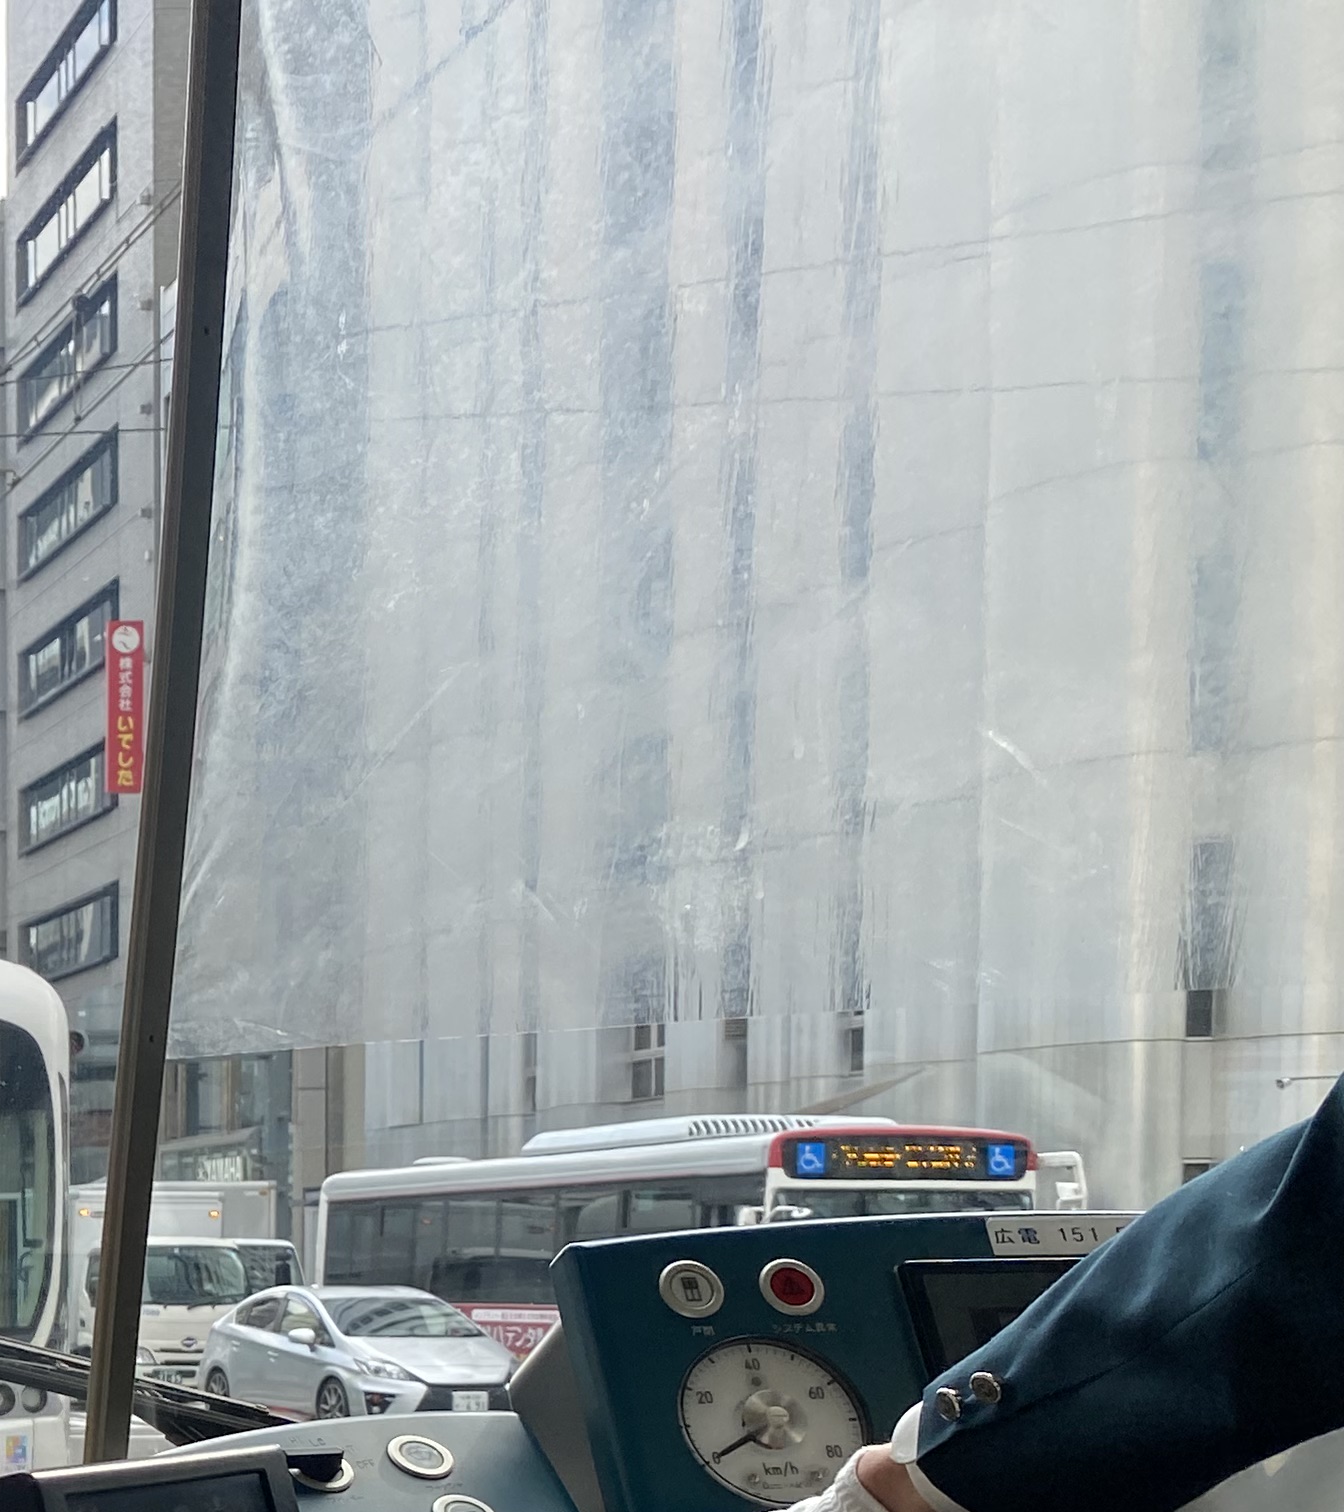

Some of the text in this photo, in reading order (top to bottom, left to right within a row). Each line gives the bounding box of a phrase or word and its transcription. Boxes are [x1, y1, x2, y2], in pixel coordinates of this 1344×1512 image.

[118, 656, 133, 712] 株式会社
[994, 1227, 1041, 1245] 広電
[1058, 1226, 1099, 1242] 151
[745, 1358, 761, 1371] 40
[696, 1391, 714, 1404] 20
[808, 1386, 825, 1399] 60
[826, 1445, 843, 1458] 80
[763, 1463, 799, 1477] km/h
